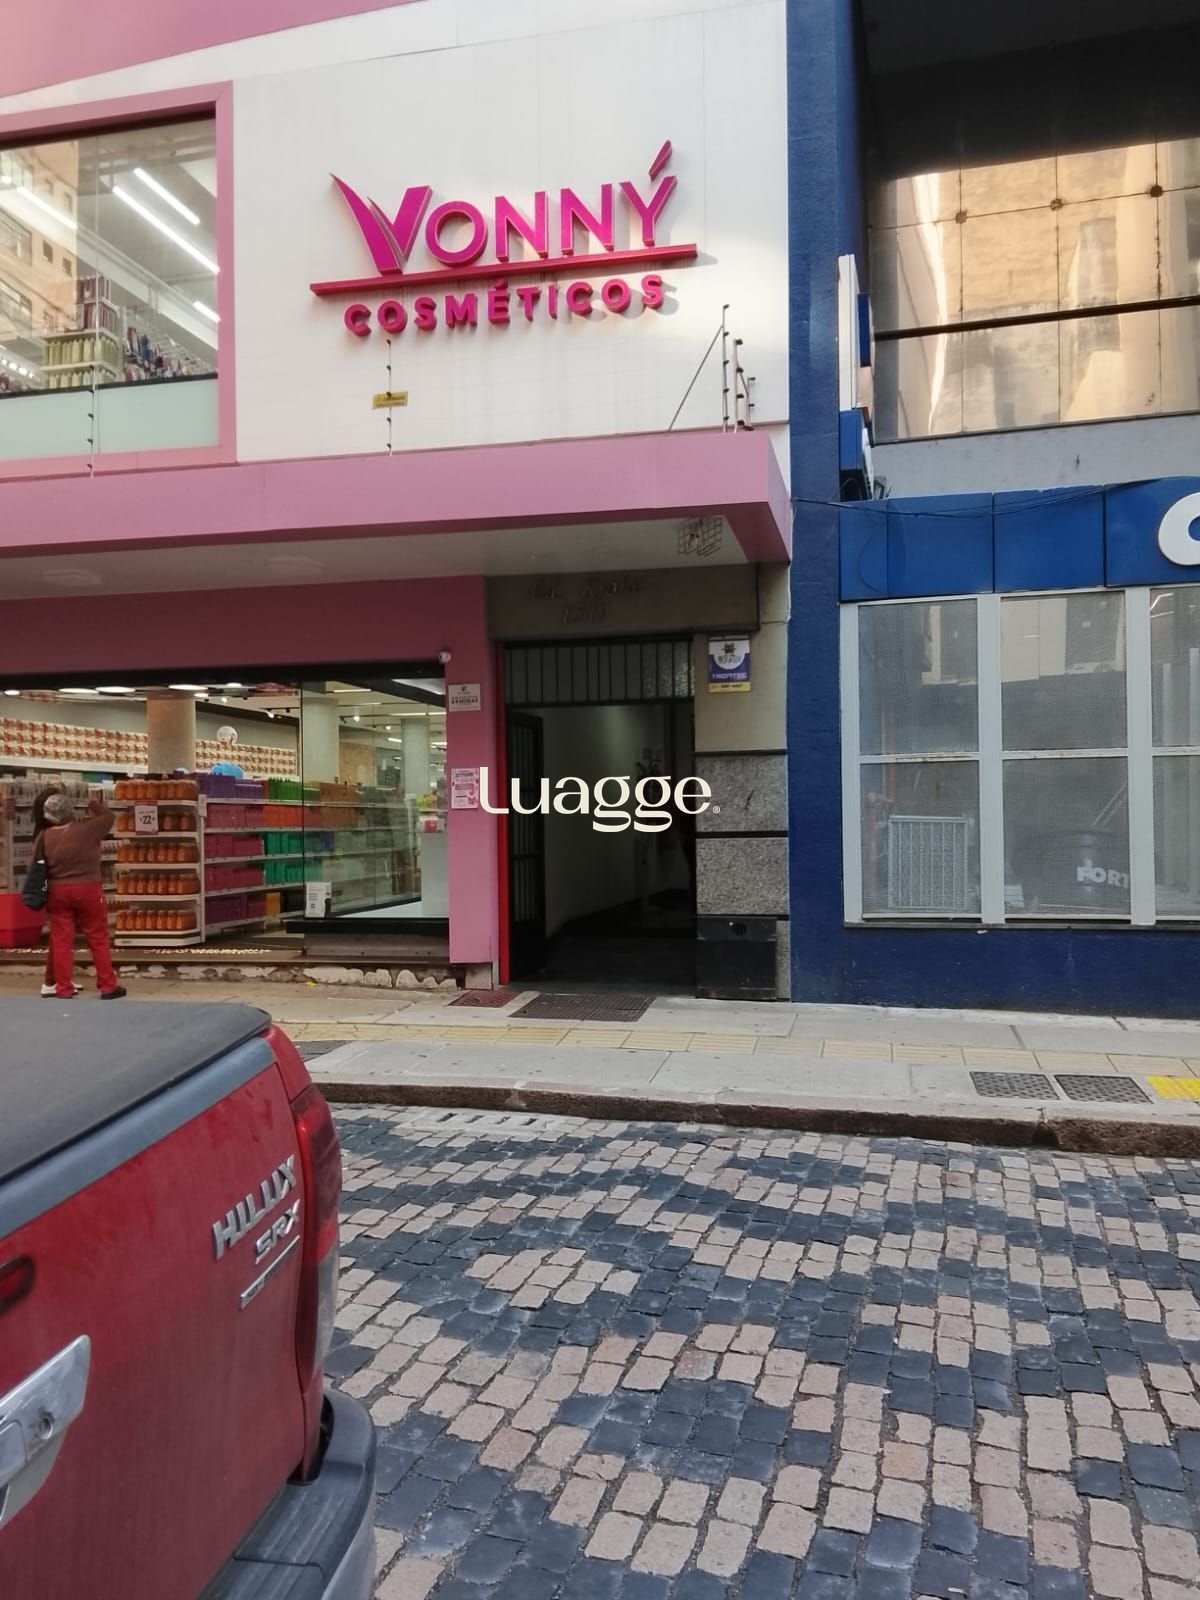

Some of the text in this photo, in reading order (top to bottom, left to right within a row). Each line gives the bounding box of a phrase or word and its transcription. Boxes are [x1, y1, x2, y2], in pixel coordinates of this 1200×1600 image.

[343, 274, 665, 337] COSMÉTICOS
[212, 1154, 297, 1261] HILUX
[255, 1198, 301, 1265] SRX
